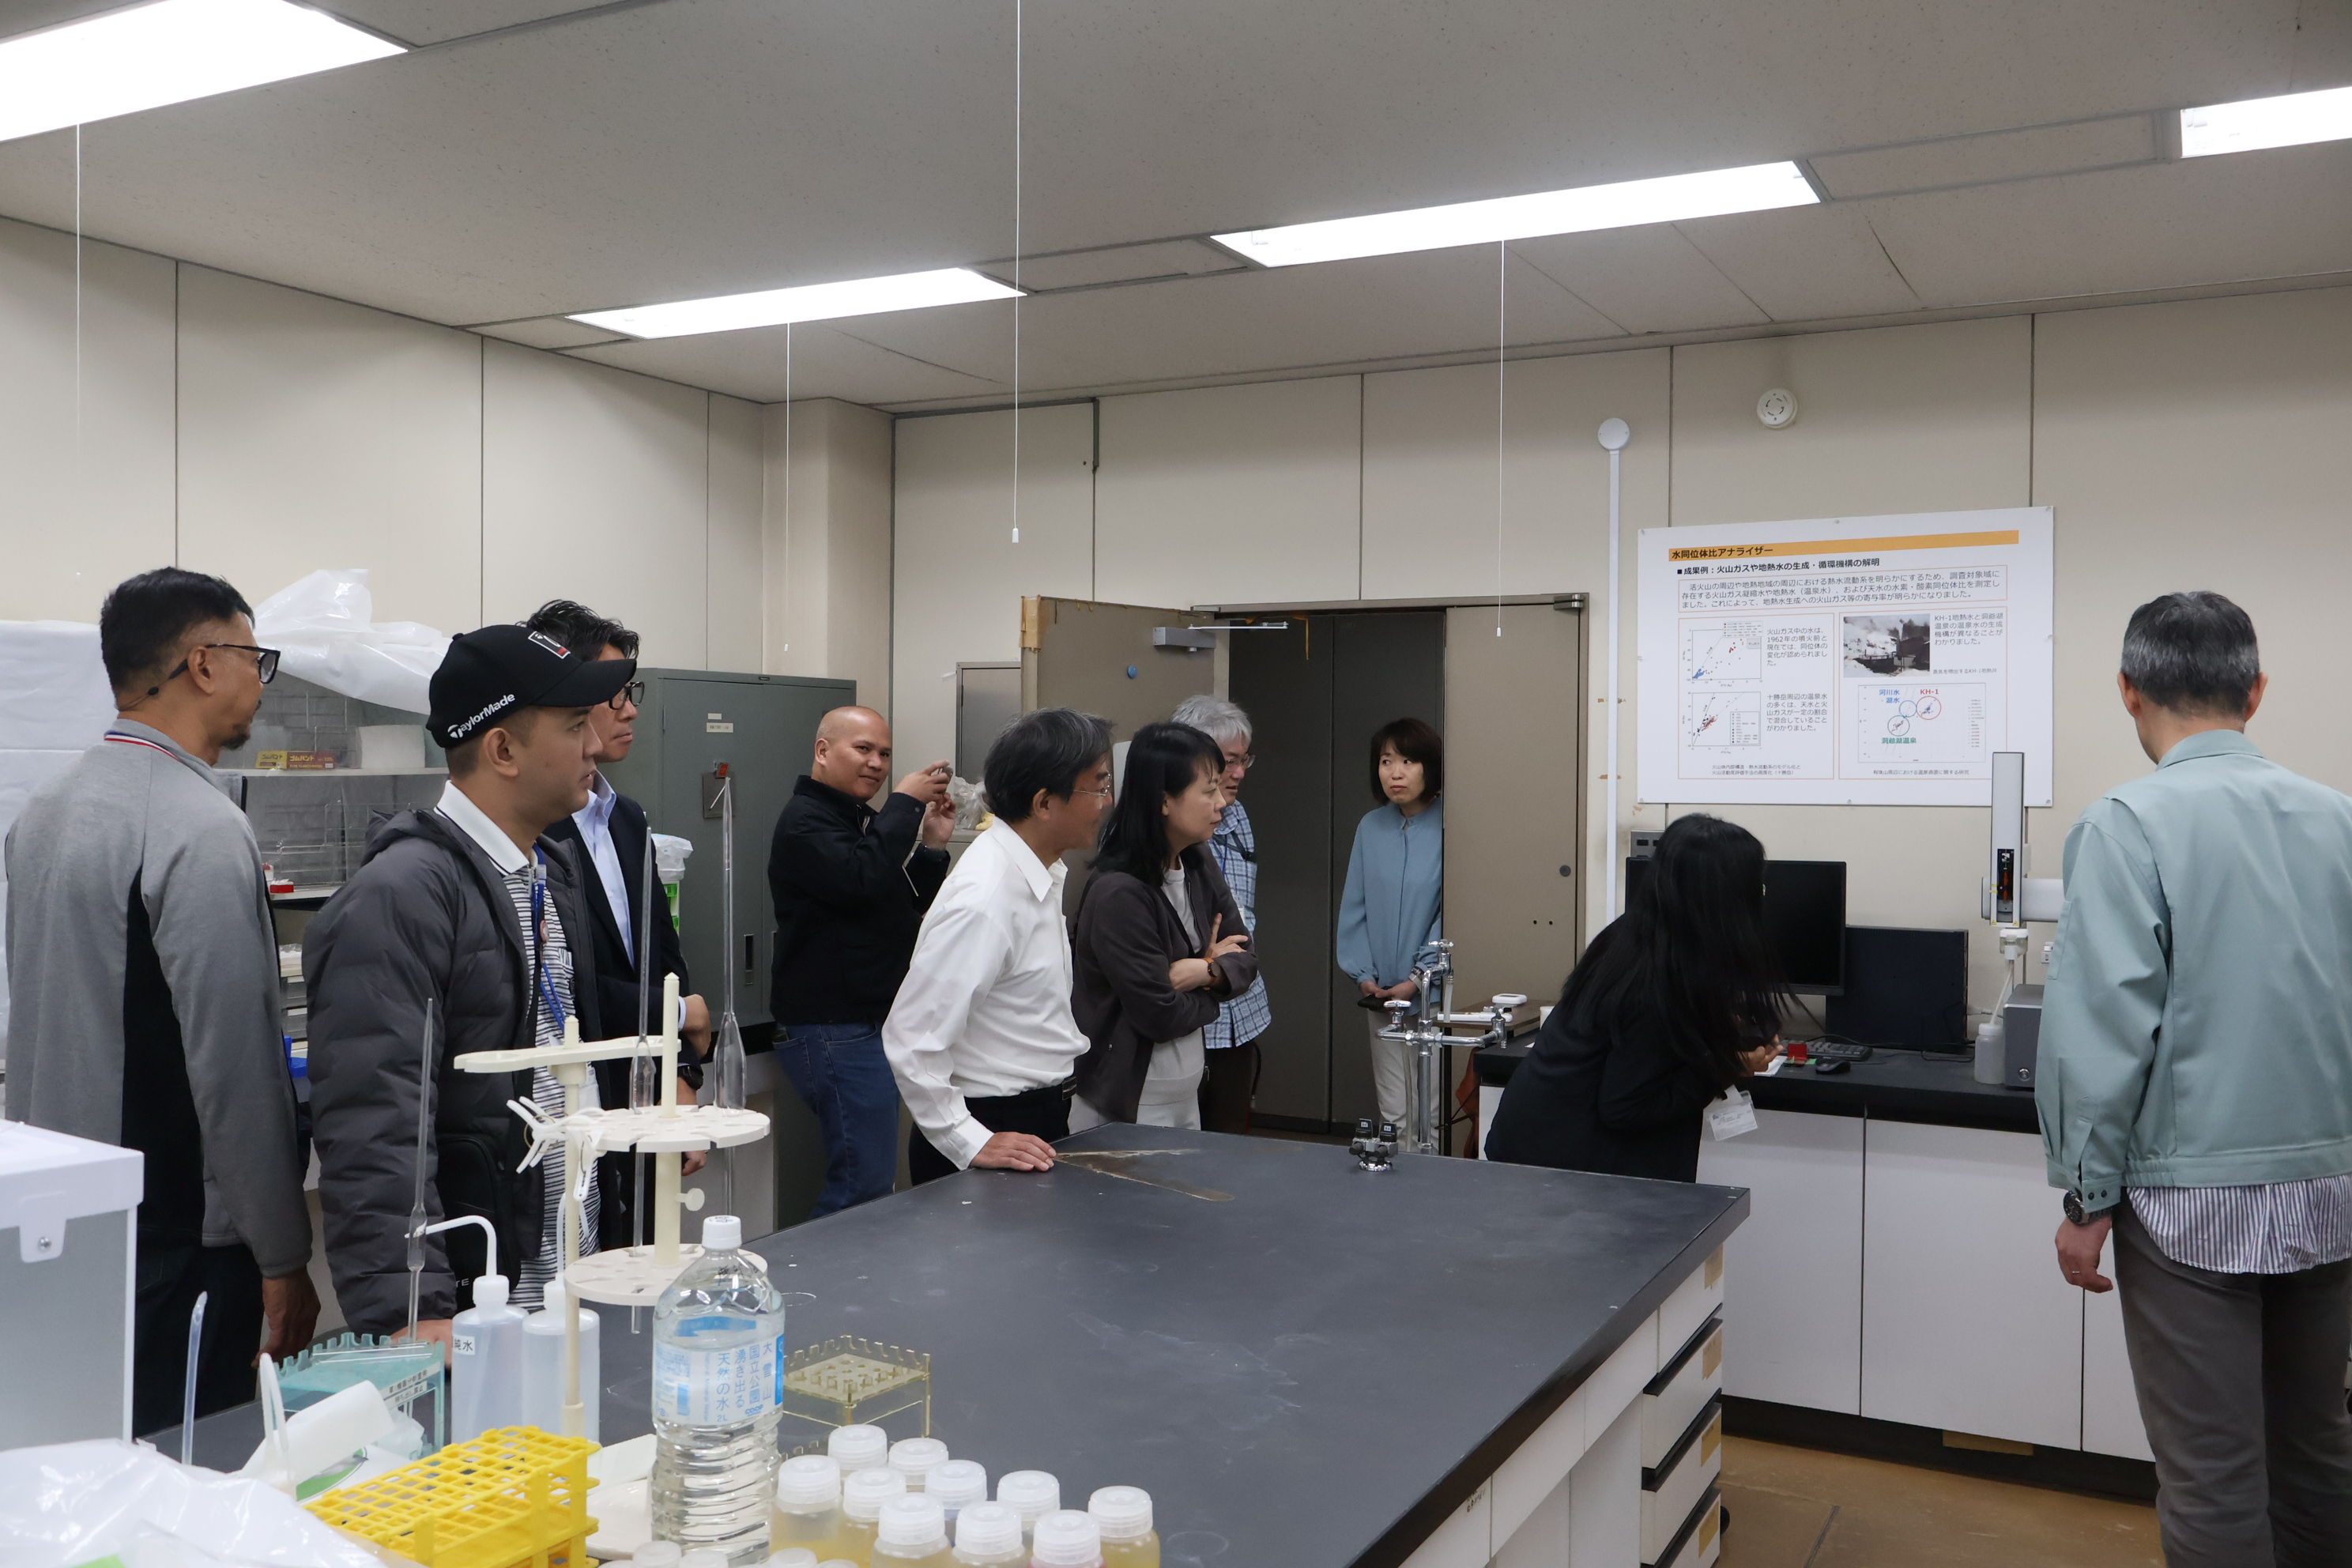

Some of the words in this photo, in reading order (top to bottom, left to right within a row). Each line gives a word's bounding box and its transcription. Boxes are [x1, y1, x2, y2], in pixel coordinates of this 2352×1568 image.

[1672, 545, 1773, 559] 水同位体比アナライザー
[1935, 629, 2003, 638] 機構が異なることが
[447, 694, 515, 739] TaylorMade
[716, 1352, 730, 1411] 天然の水
[734, 1349, 746, 1408] 湧き出る
[749, 1344, 760, 1404] 国立公園
